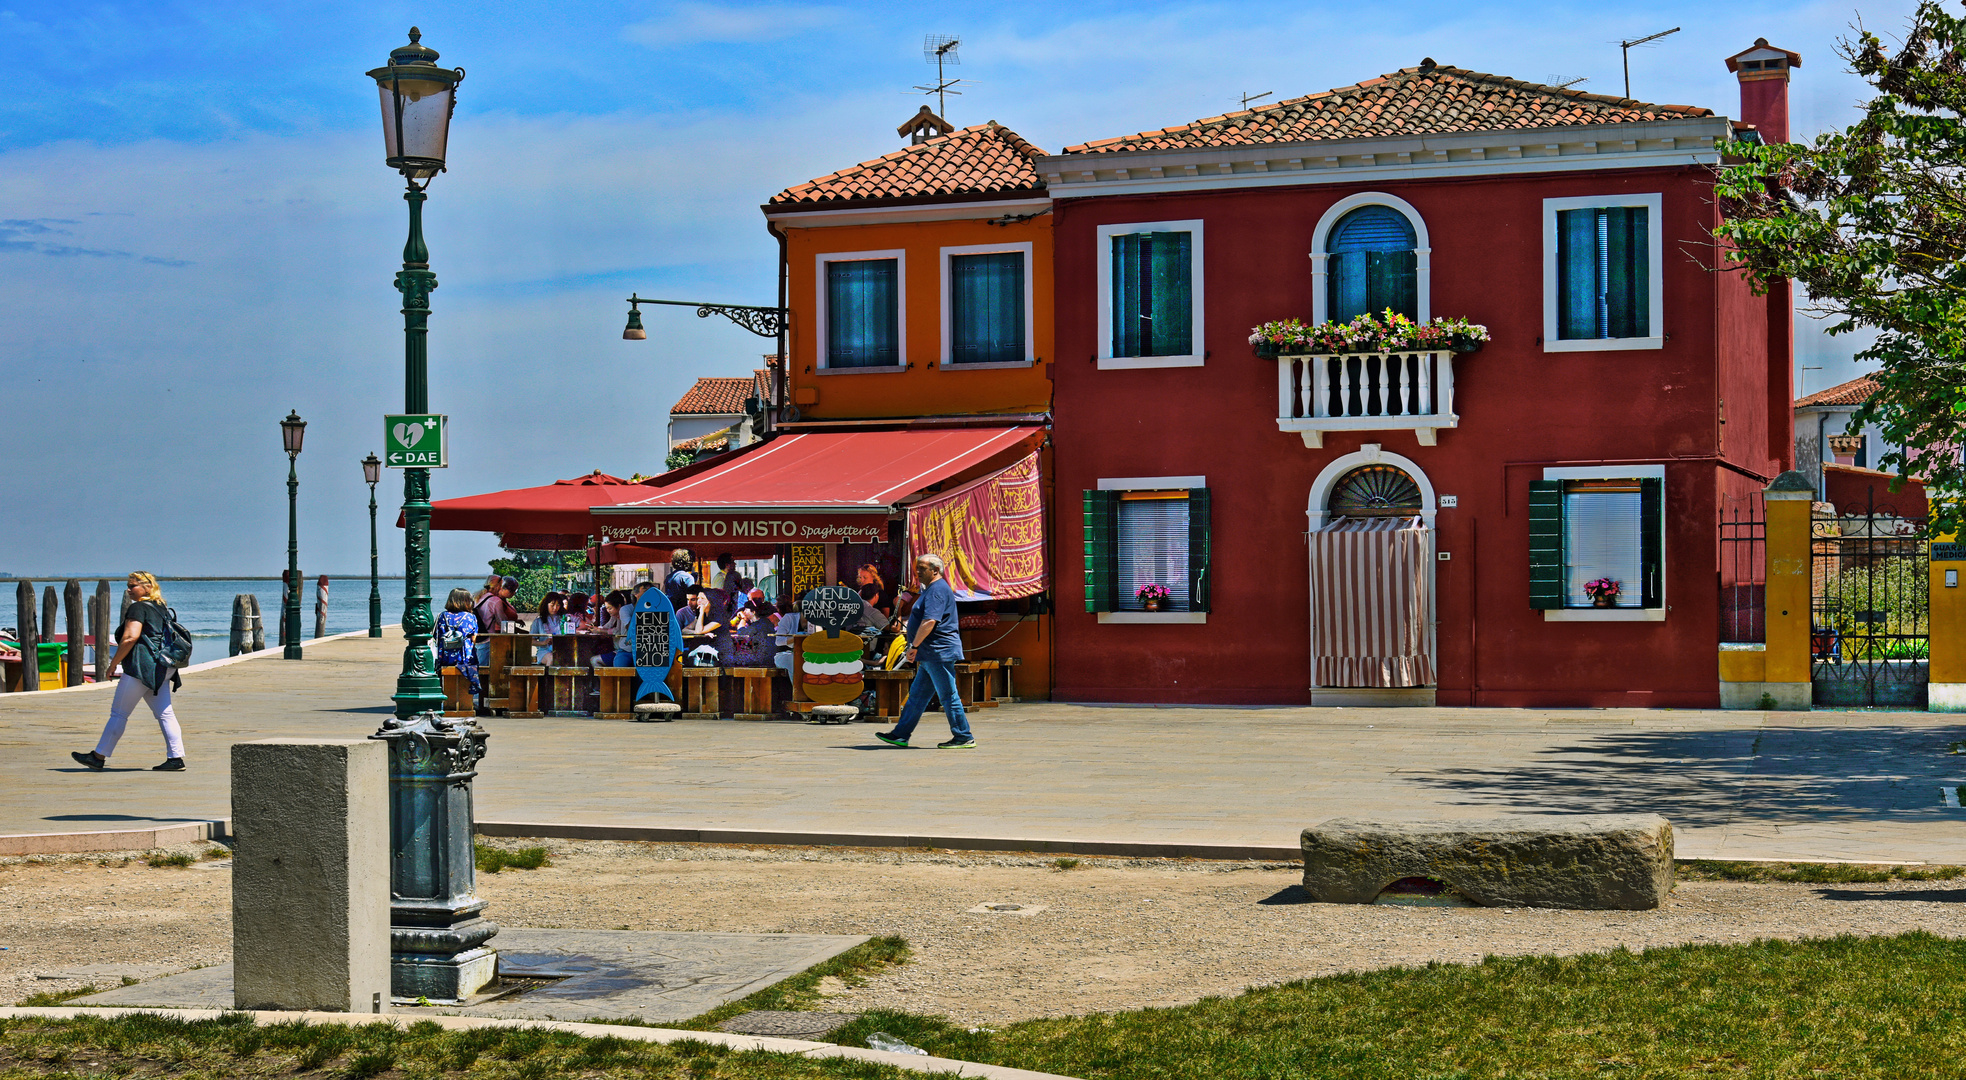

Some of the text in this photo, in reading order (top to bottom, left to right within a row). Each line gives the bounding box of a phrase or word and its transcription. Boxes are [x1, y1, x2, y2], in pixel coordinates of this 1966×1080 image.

[406, 452, 437, 462] DAE
[600, 520, 880, 539] Pizzeria FRITTO MISTO Spaghetteria
[793, 545, 824, 556] PESCE
[793, 556, 824, 565] PANINI
[794, 565, 825, 575] PIZZA
[802, 600, 837, 610] PANINO
[635, 612, 670, 625] MENU
[804, 609, 834, 619] PATATE
[636, 625, 669, 635] PESCE
[635, 634, 670, 643] FRITTO
[635, 642, 669, 652] PATATE
